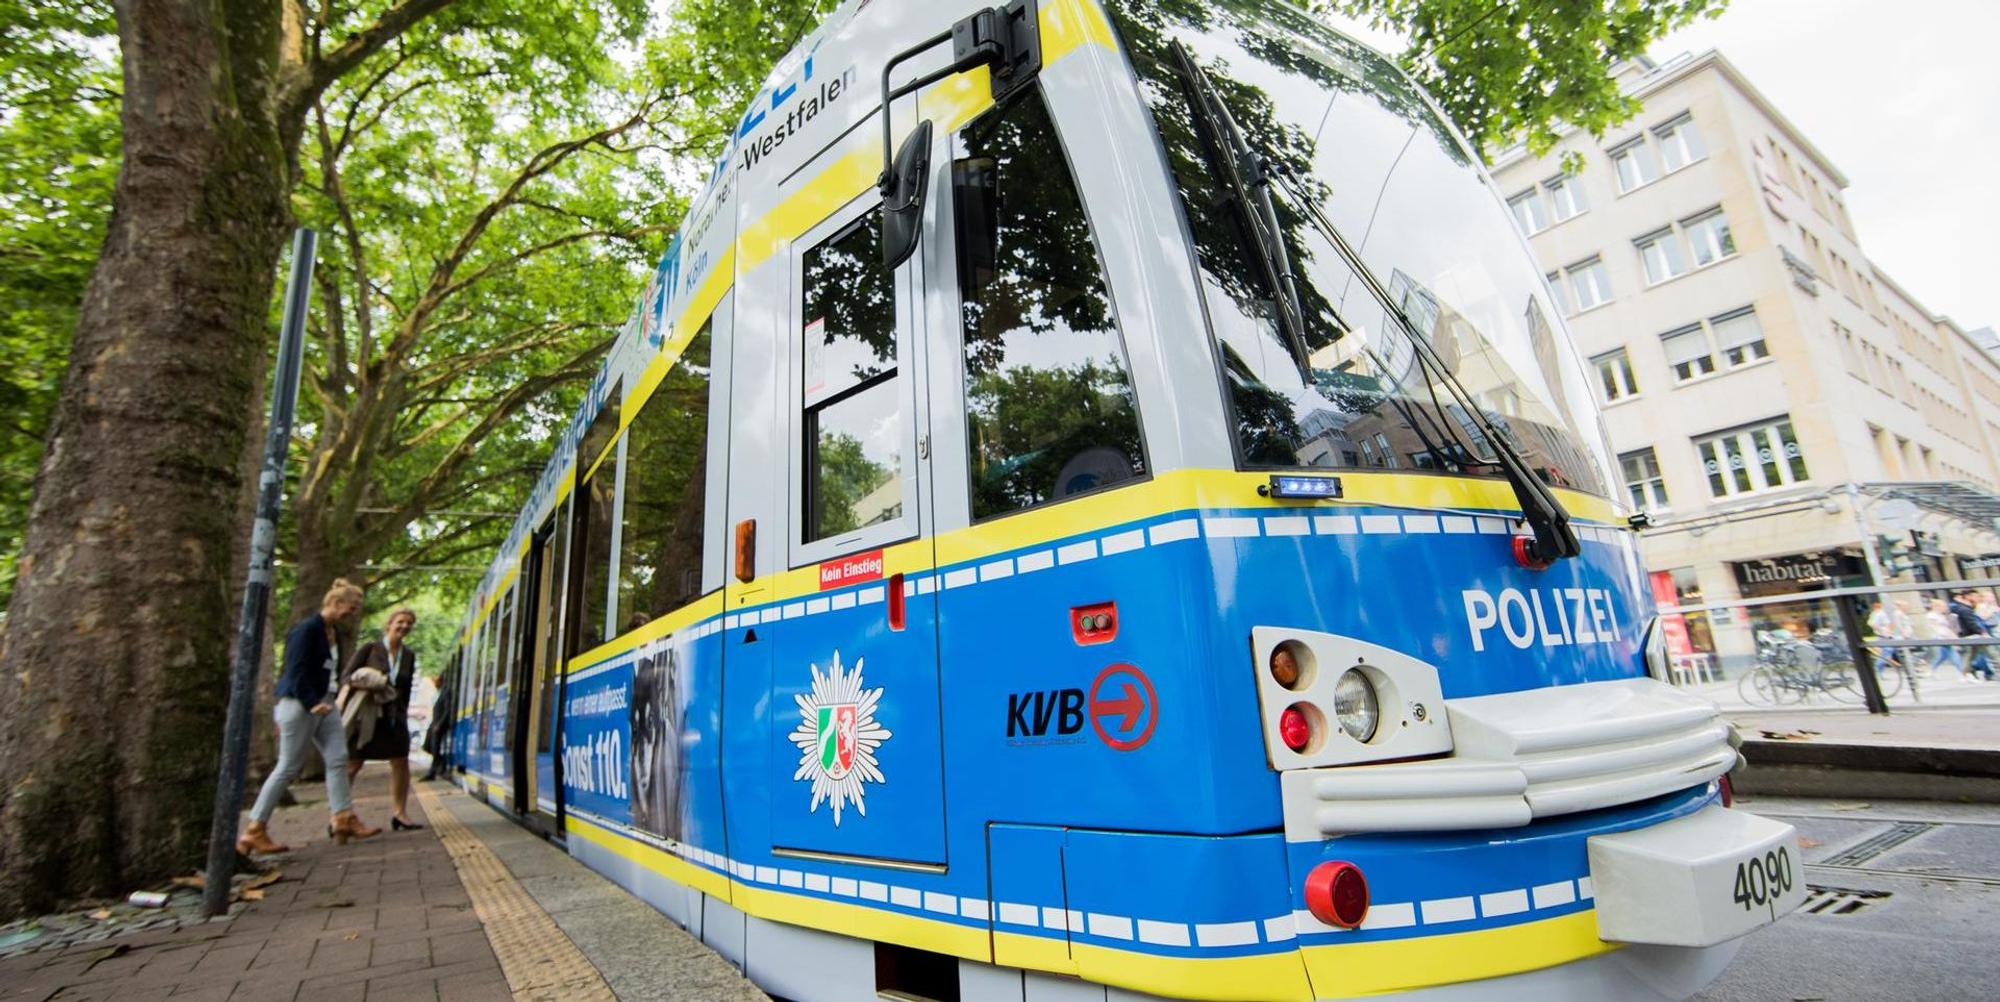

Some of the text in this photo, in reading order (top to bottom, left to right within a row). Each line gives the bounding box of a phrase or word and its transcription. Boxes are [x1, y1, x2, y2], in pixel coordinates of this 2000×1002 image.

[822, 558, 882, 582] Kein Einstieg
[1742, 559, 1824, 583] habitat
[1462, 588, 1621, 652] POLIZEI
[1006, 688, 1085, 737] KVB
[595, 728, 627, 799] 110.
[1734, 845, 1792, 911] 4090
